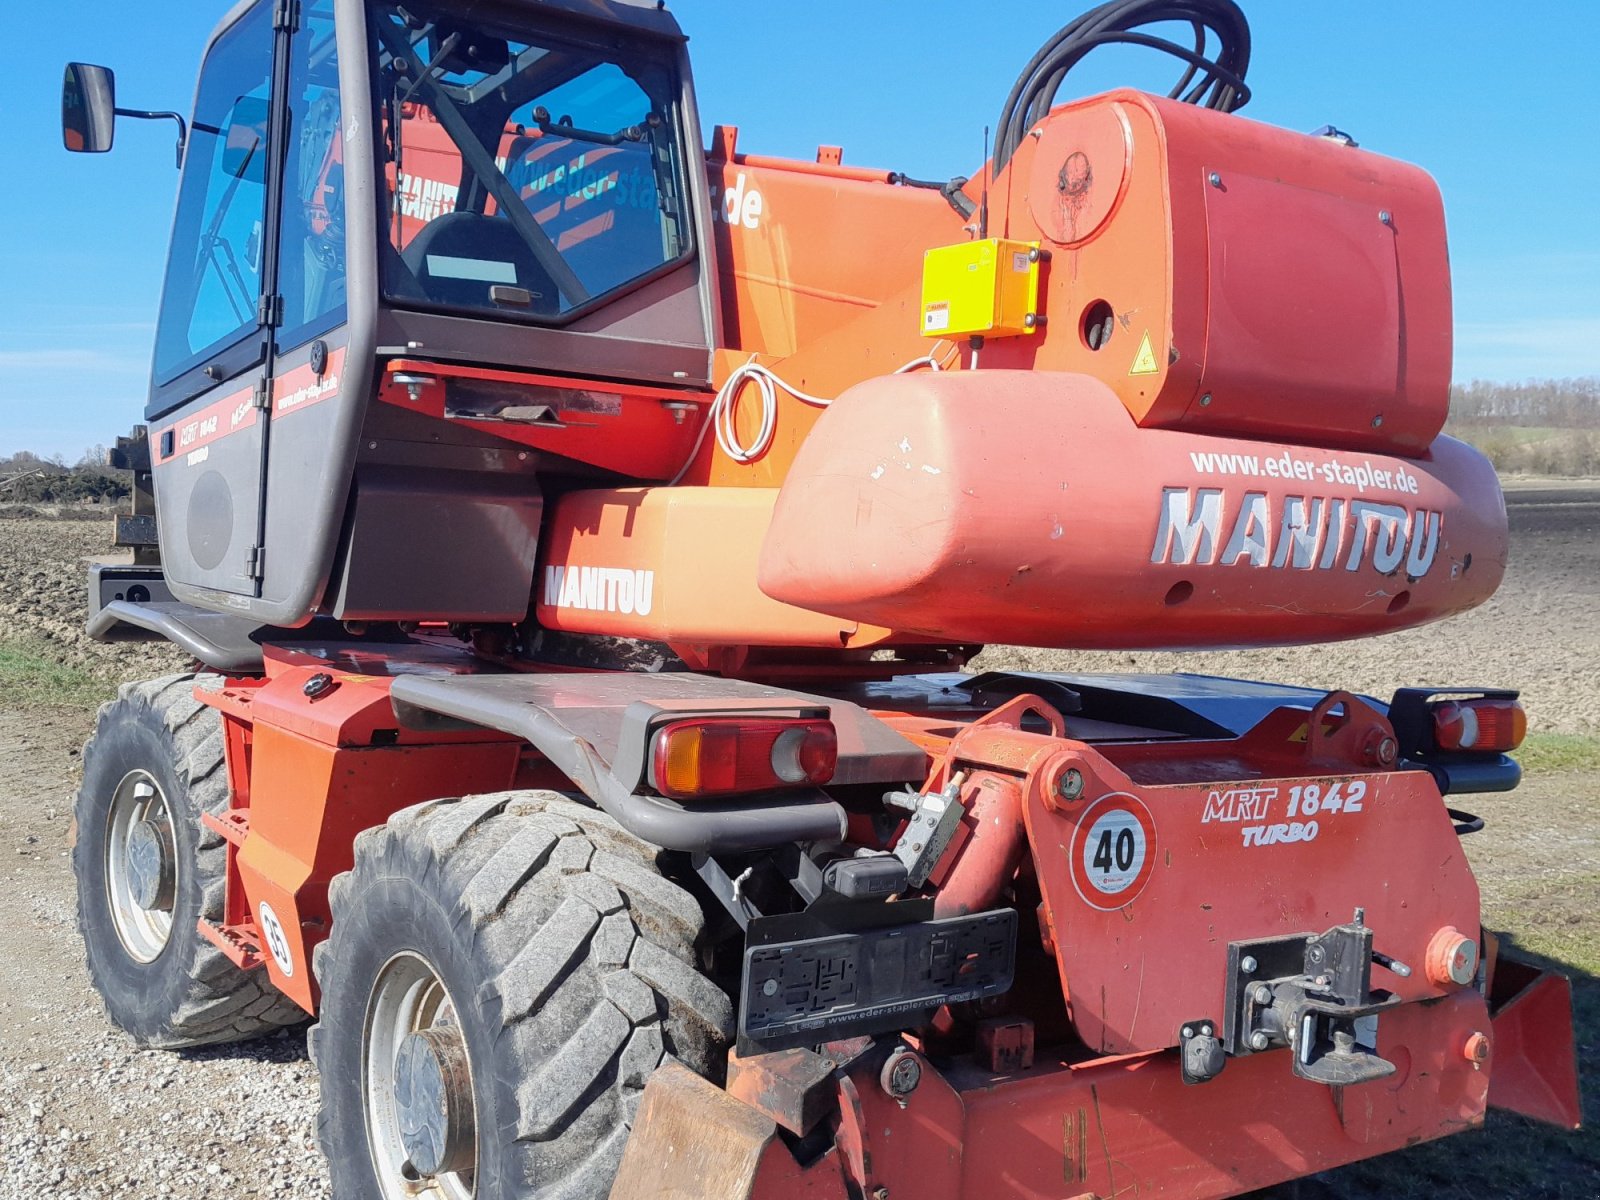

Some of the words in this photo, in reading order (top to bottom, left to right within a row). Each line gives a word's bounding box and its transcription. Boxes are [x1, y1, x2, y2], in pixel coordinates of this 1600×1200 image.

[1189, 451, 1419, 495] www.eder-stapler.de
[1150, 486, 1442, 578] MANITOU
[544, 565, 654, 616] MANITOU
[1201, 787, 1278, 824] MRT
[1286, 781, 1367, 818] 1842
[1093, 827, 1134, 874] 40
[1241, 820, 1319, 848] TURBO
[264, 914, 288, 965] 35
[828, 996, 946, 1025] www.eder-stapler.com
